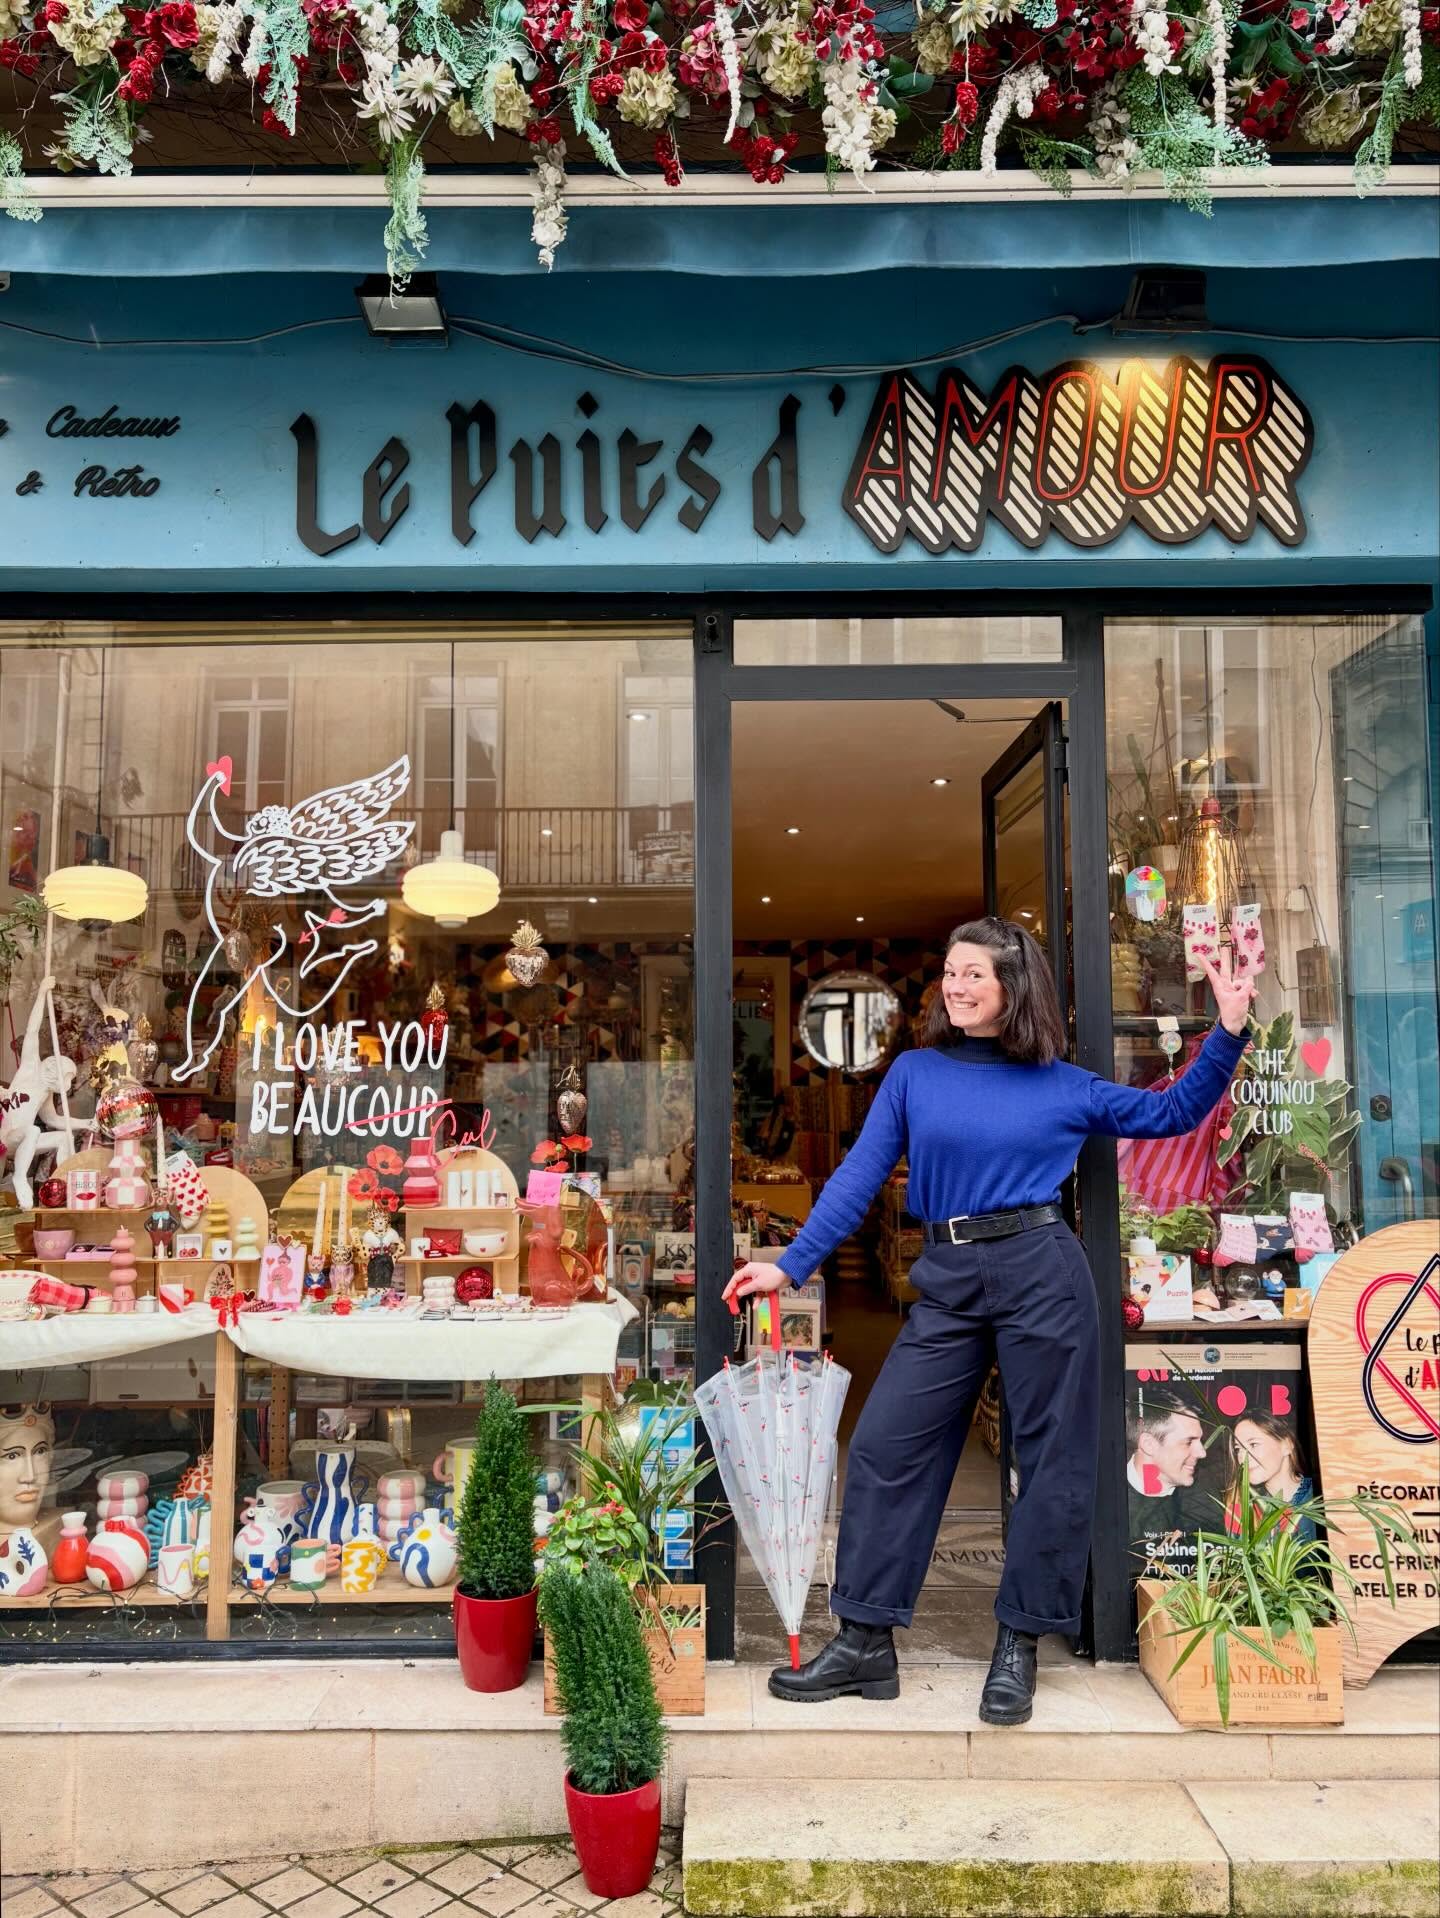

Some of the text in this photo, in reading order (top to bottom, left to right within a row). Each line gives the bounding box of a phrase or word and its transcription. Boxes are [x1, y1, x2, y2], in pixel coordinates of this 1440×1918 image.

[46, 405, 181, 438] Cadeaux
[16, 470, 43, 496] &
[289, 410, 410, 557] Le
[445, 390, 721, 547] Puits
[252, 1019, 449, 1073] I LOVE YOU
[1255, 1048, 1289, 1075] THE
[1230, 1079, 1315, 1108] COQUINOU
[250, 1080, 439, 1137] BEAUCOUP
[1252, 1110, 1294, 1134] CLUB
[1354, 1583, 1417, 1598] ATELER
